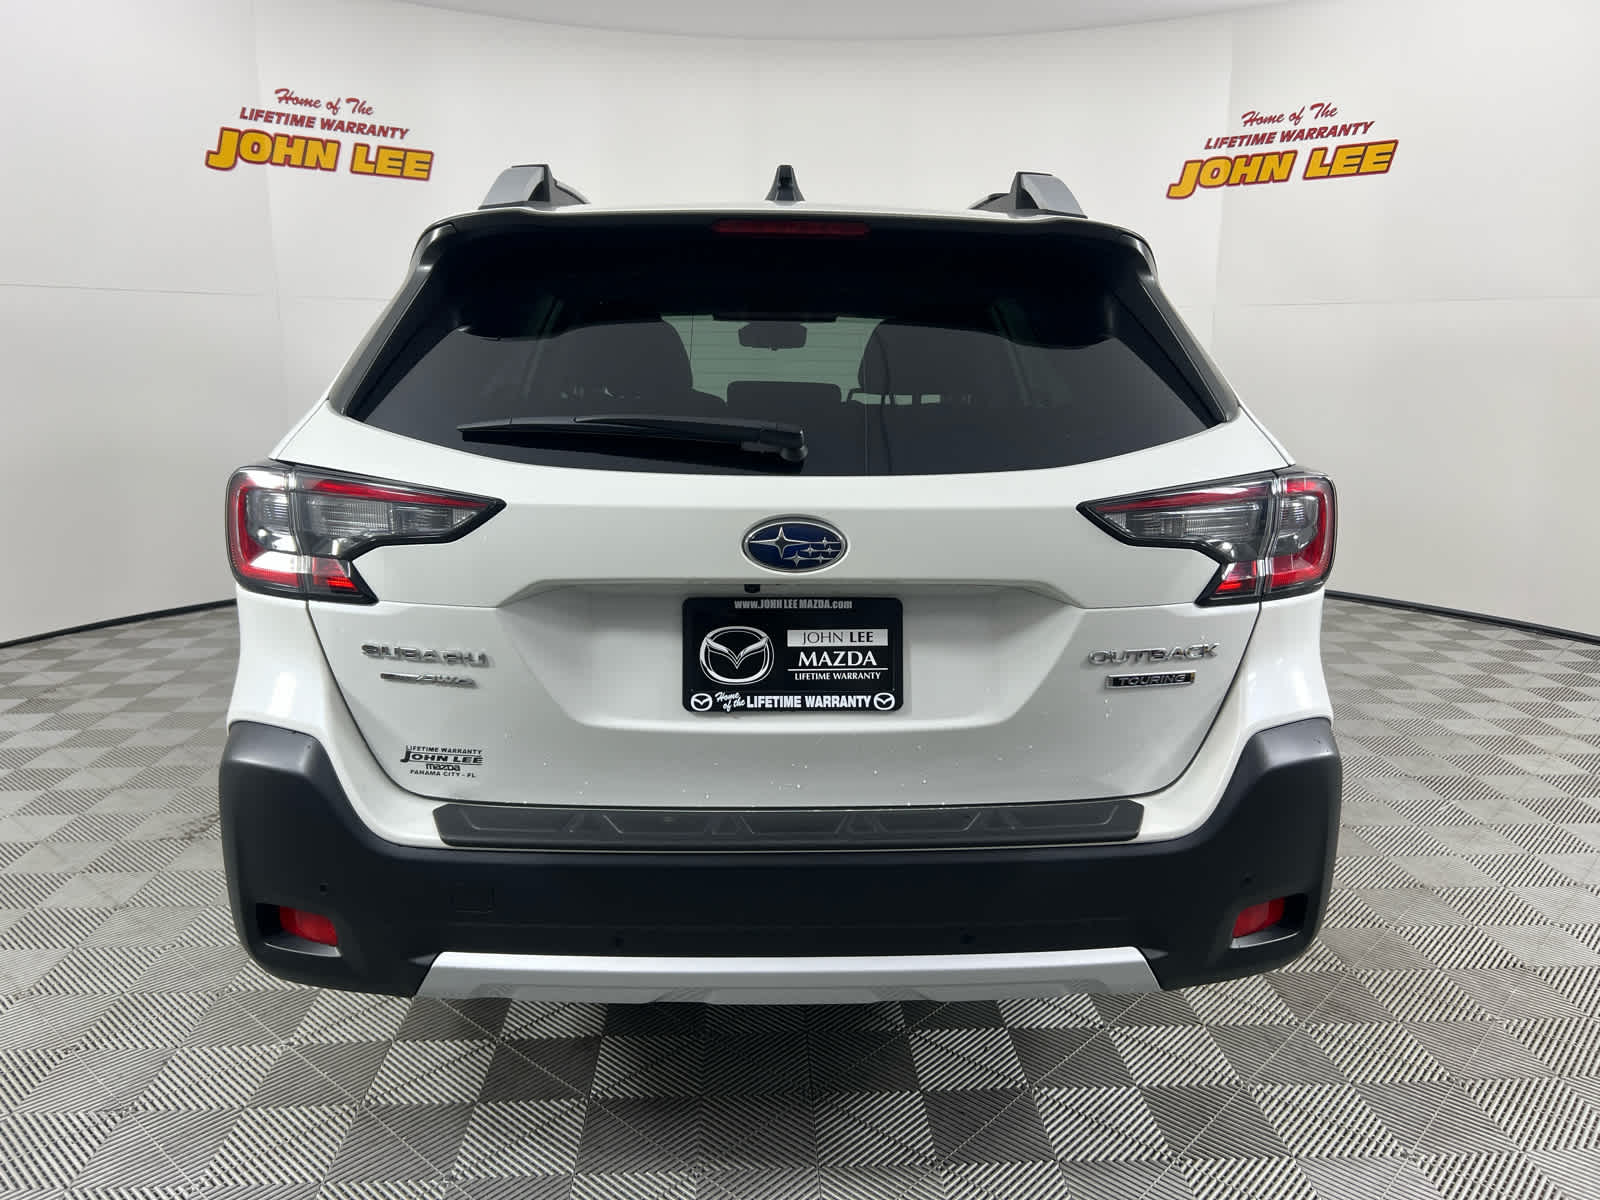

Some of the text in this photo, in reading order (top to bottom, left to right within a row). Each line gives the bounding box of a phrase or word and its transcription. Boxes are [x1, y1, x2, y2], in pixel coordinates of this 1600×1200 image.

[274, 87, 374, 115] Home of The
[1241, 102, 1338, 127] Home of The
[239, 106, 410, 140] LIFETIME WARRANTY
[1204, 120, 1375, 150] LIFETIME WARRANTY
[204, 126, 434, 182] JOHN LEE
[1166, 139, 1399, 200] JOHN LEE
[802, 631, 874, 644] JOHN LEE
[361, 644, 491, 668] SUBARU
[798, 651, 877, 667] MAZDA
[1088, 642, 1220, 665] OUTBACK
[794, 671, 881, 681] LIFETIME WARRANTY
[1118, 674, 1186, 686] TOURING
[715, 691, 740, 702] Home
[733, 697, 746, 707] the
[746, 695, 872, 708] LIFETIME WARRANTY
[400, 750, 484, 764] JOHN LEE
[406, 745, 483, 755] LIFETIME WARRANTY
[425, 763, 461, 771] mazda
